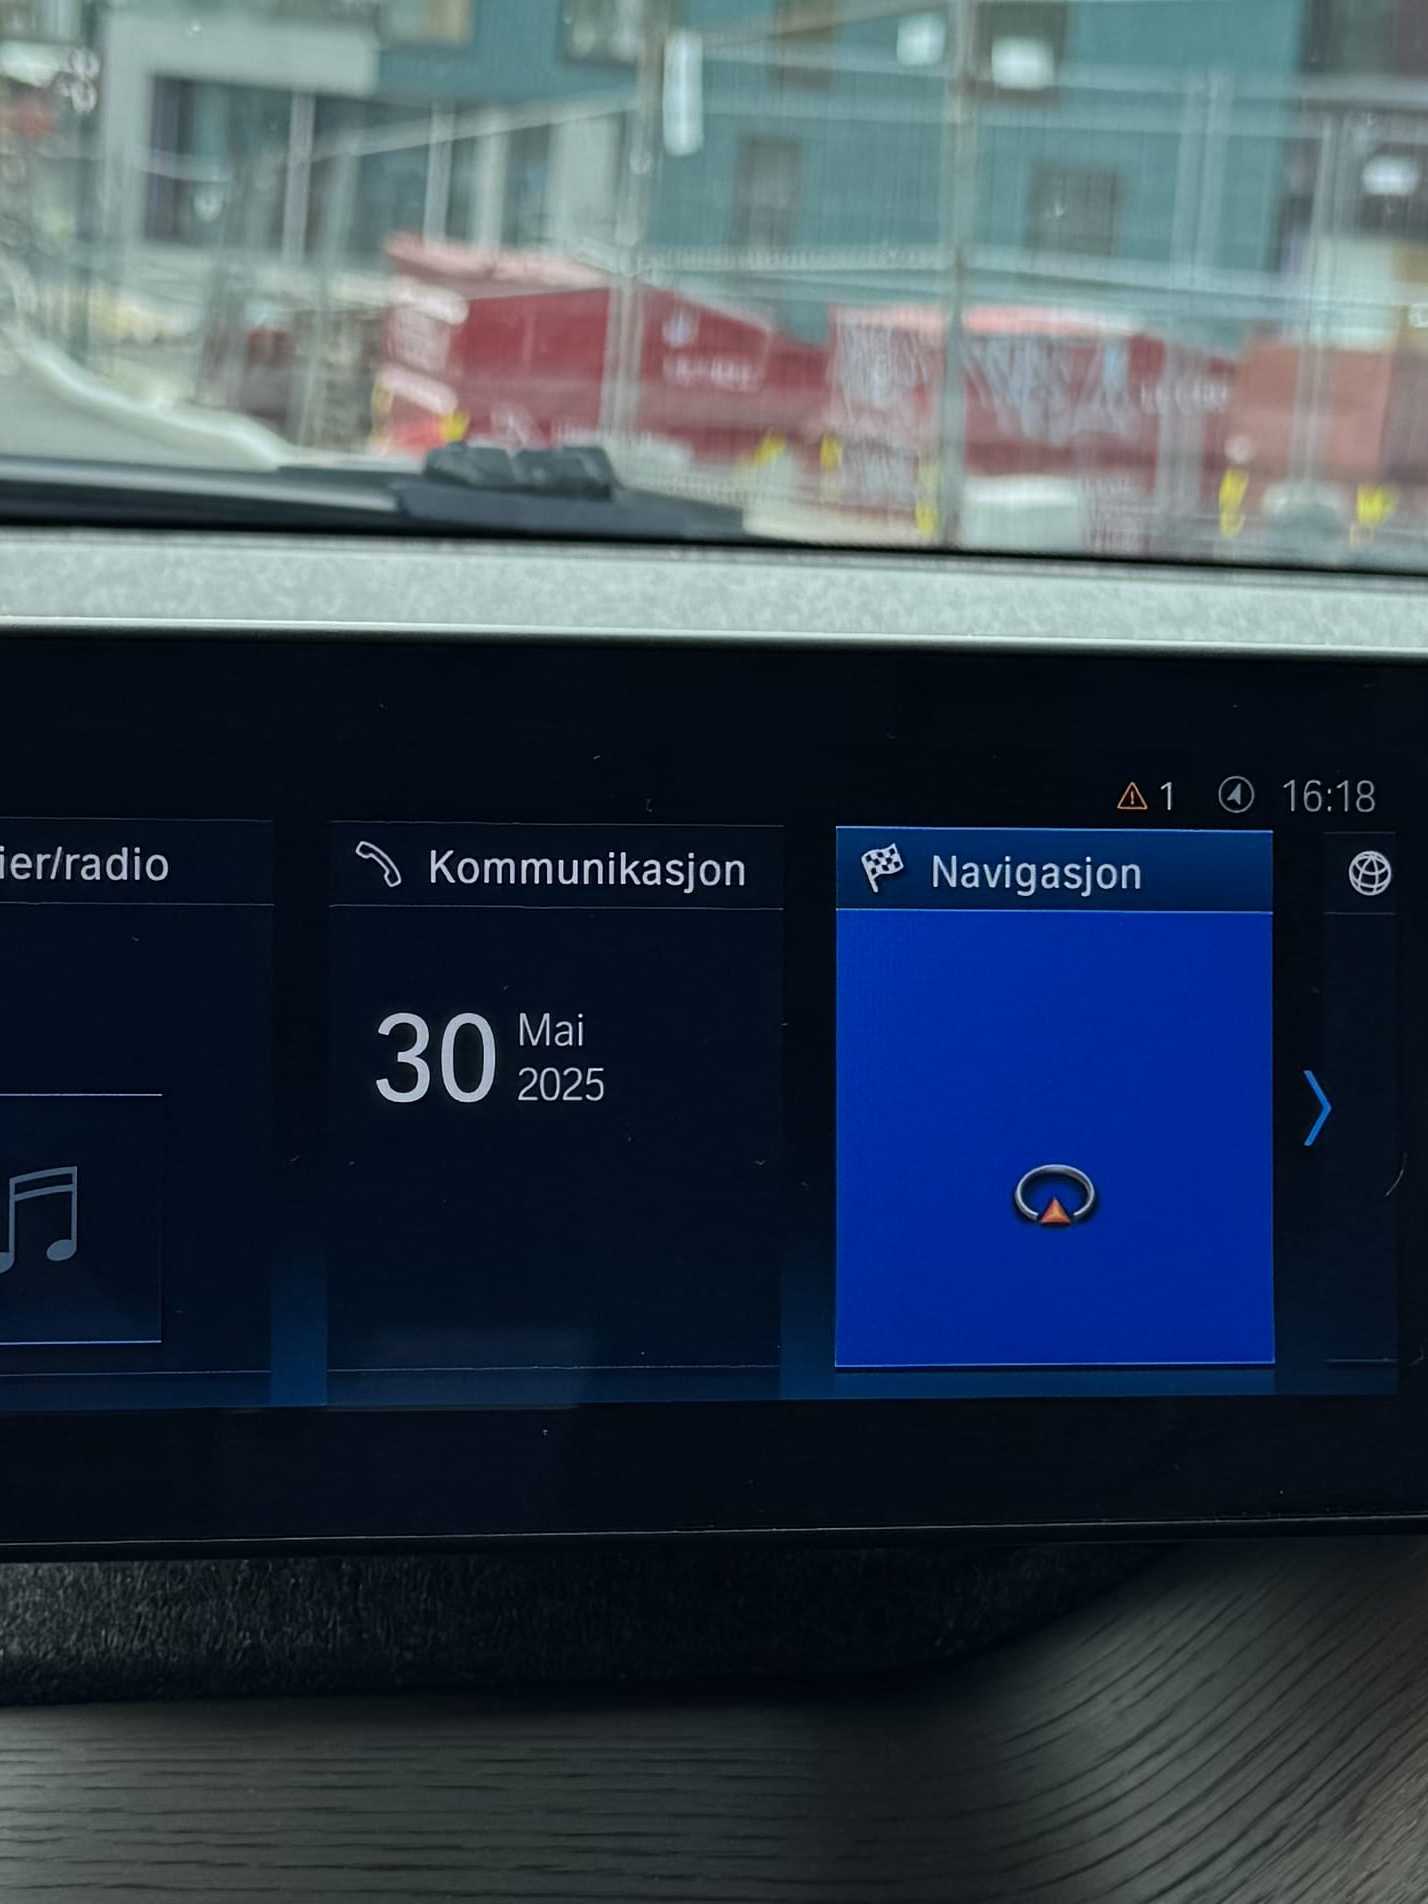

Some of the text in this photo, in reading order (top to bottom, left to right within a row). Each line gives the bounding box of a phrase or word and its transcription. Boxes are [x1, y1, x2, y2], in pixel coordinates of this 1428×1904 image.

[1160, 781, 1173, 811] 1
[1282, 779, 1376, 813] 16:18
[430, 849, 745, 894] Kommunikasjon
[933, 854, 1141, 897] Navigasjon
[519, 1012, 584, 1047] Mai
[375, 1012, 496, 1103] 30
[517, 1066, 605, 1102] 2025
